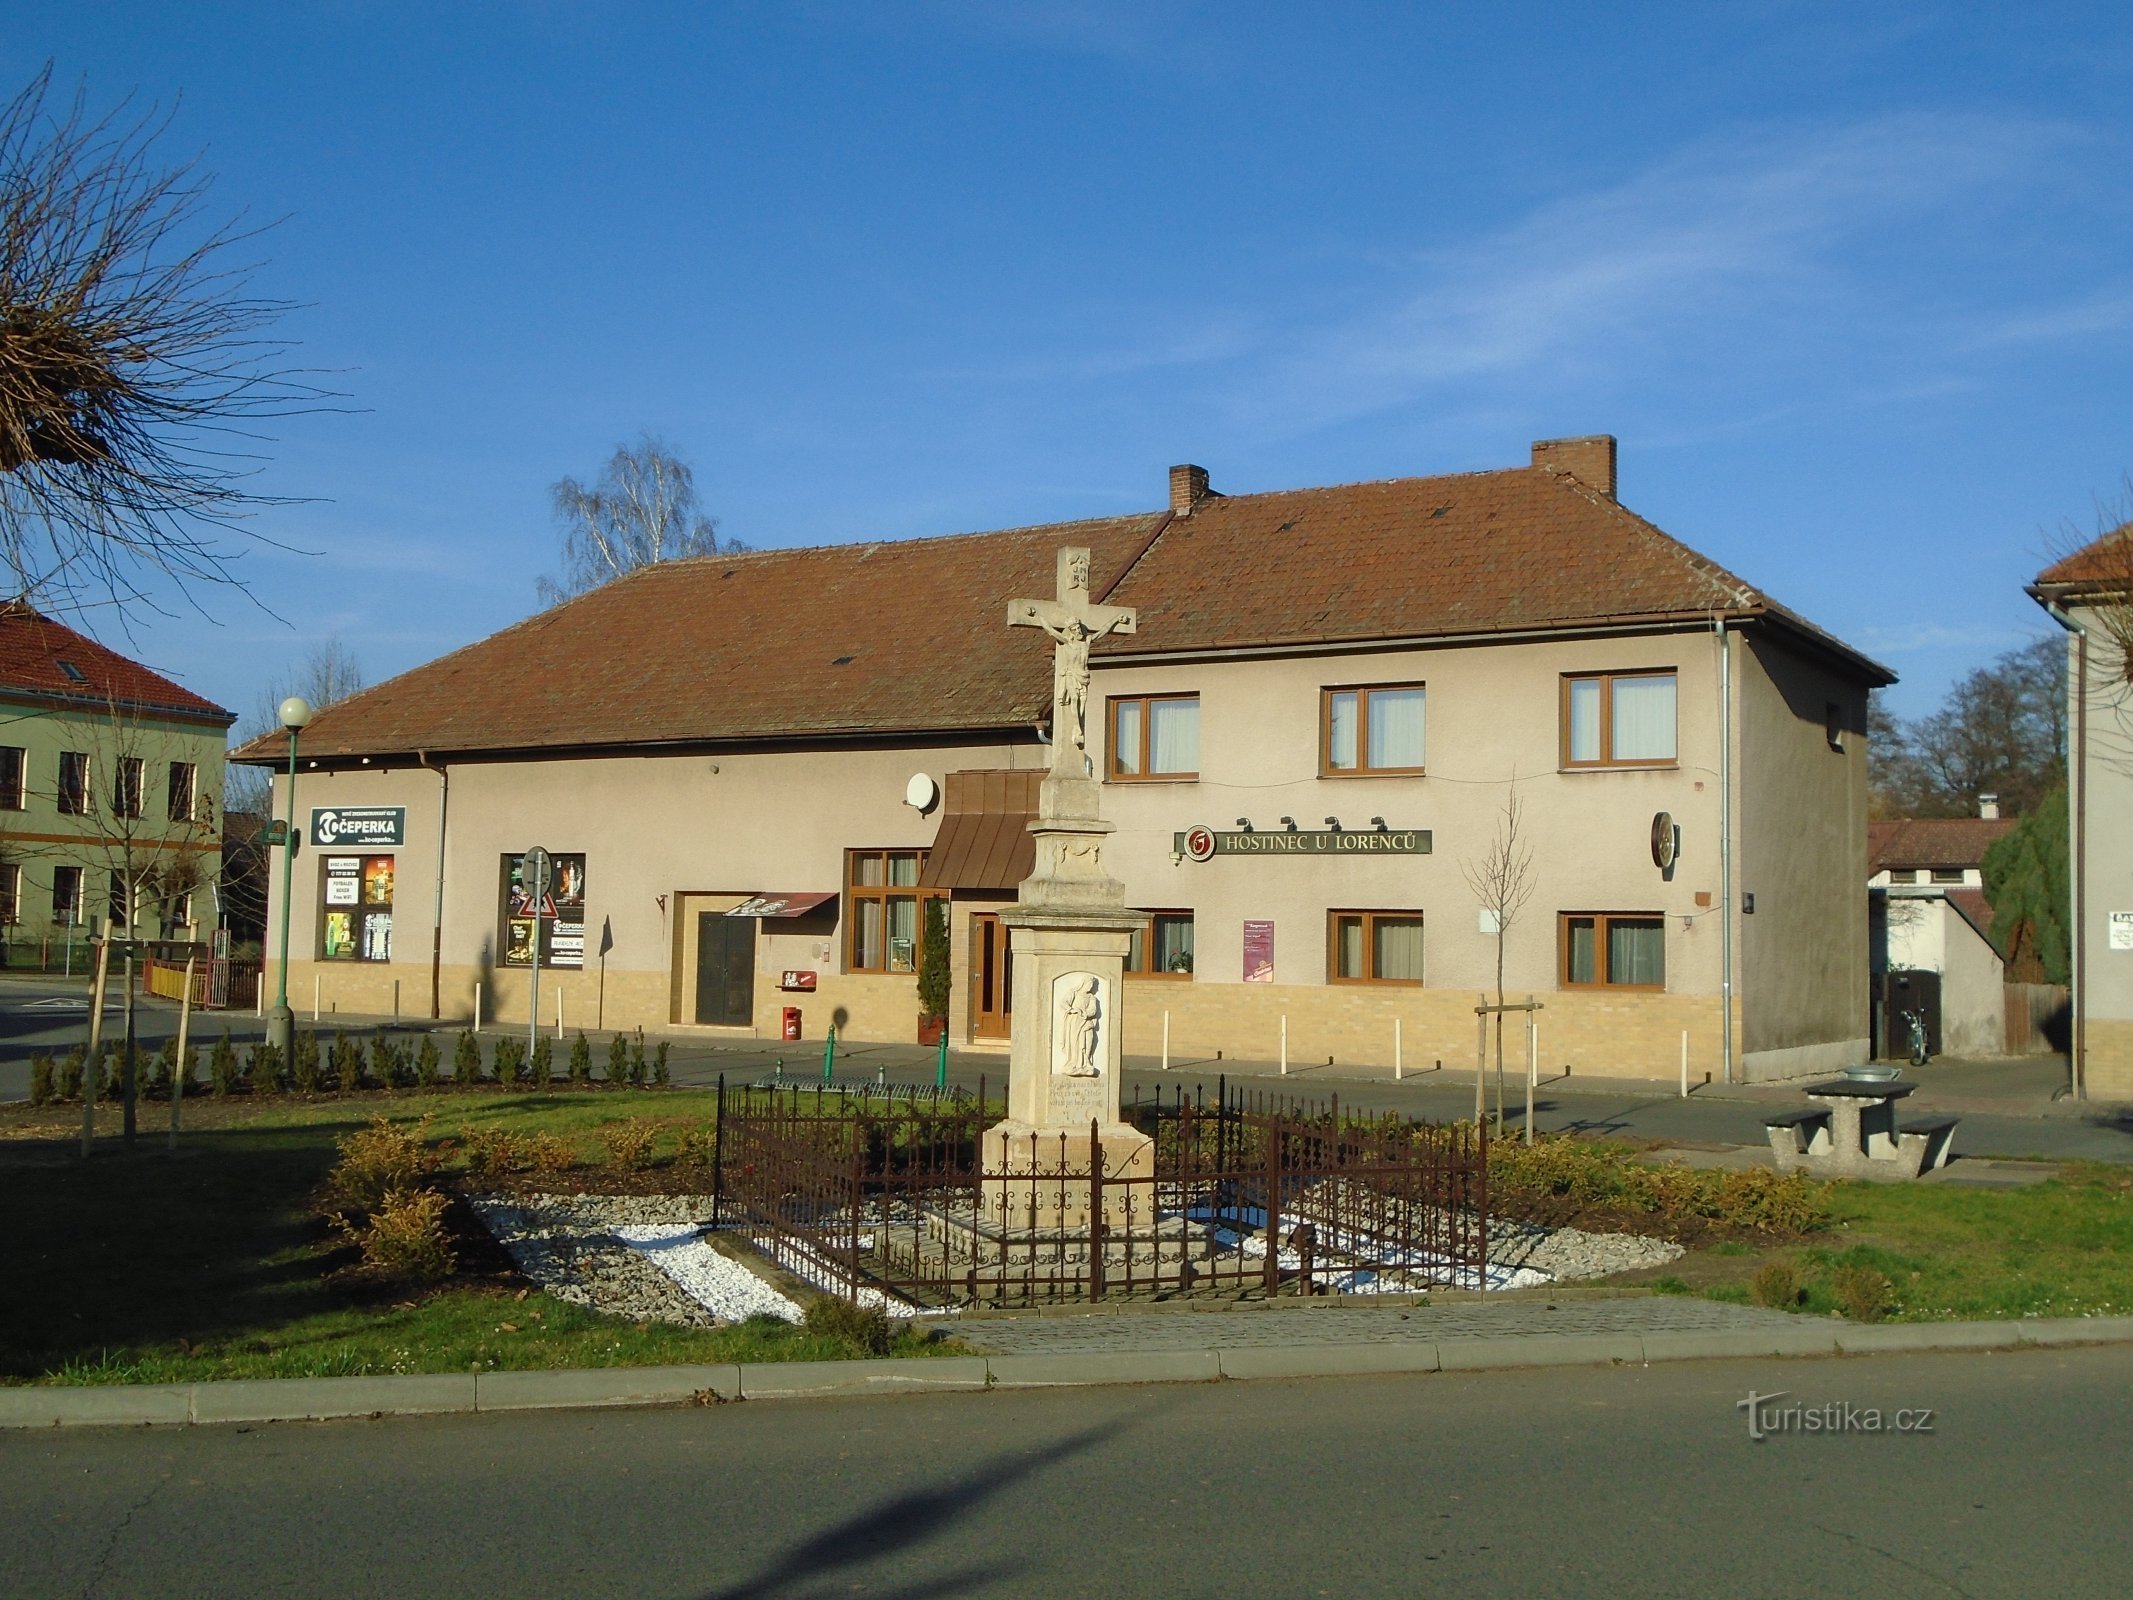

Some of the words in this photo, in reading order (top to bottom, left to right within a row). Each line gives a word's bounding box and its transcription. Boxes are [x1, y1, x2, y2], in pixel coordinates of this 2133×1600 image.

[339, 818, 396, 834] ČEPERKA
[1226, 835, 1308, 850] HOSTINEC
[1316, 835, 1328, 850] U
[1335, 831, 1416, 850] LORENCŮ
